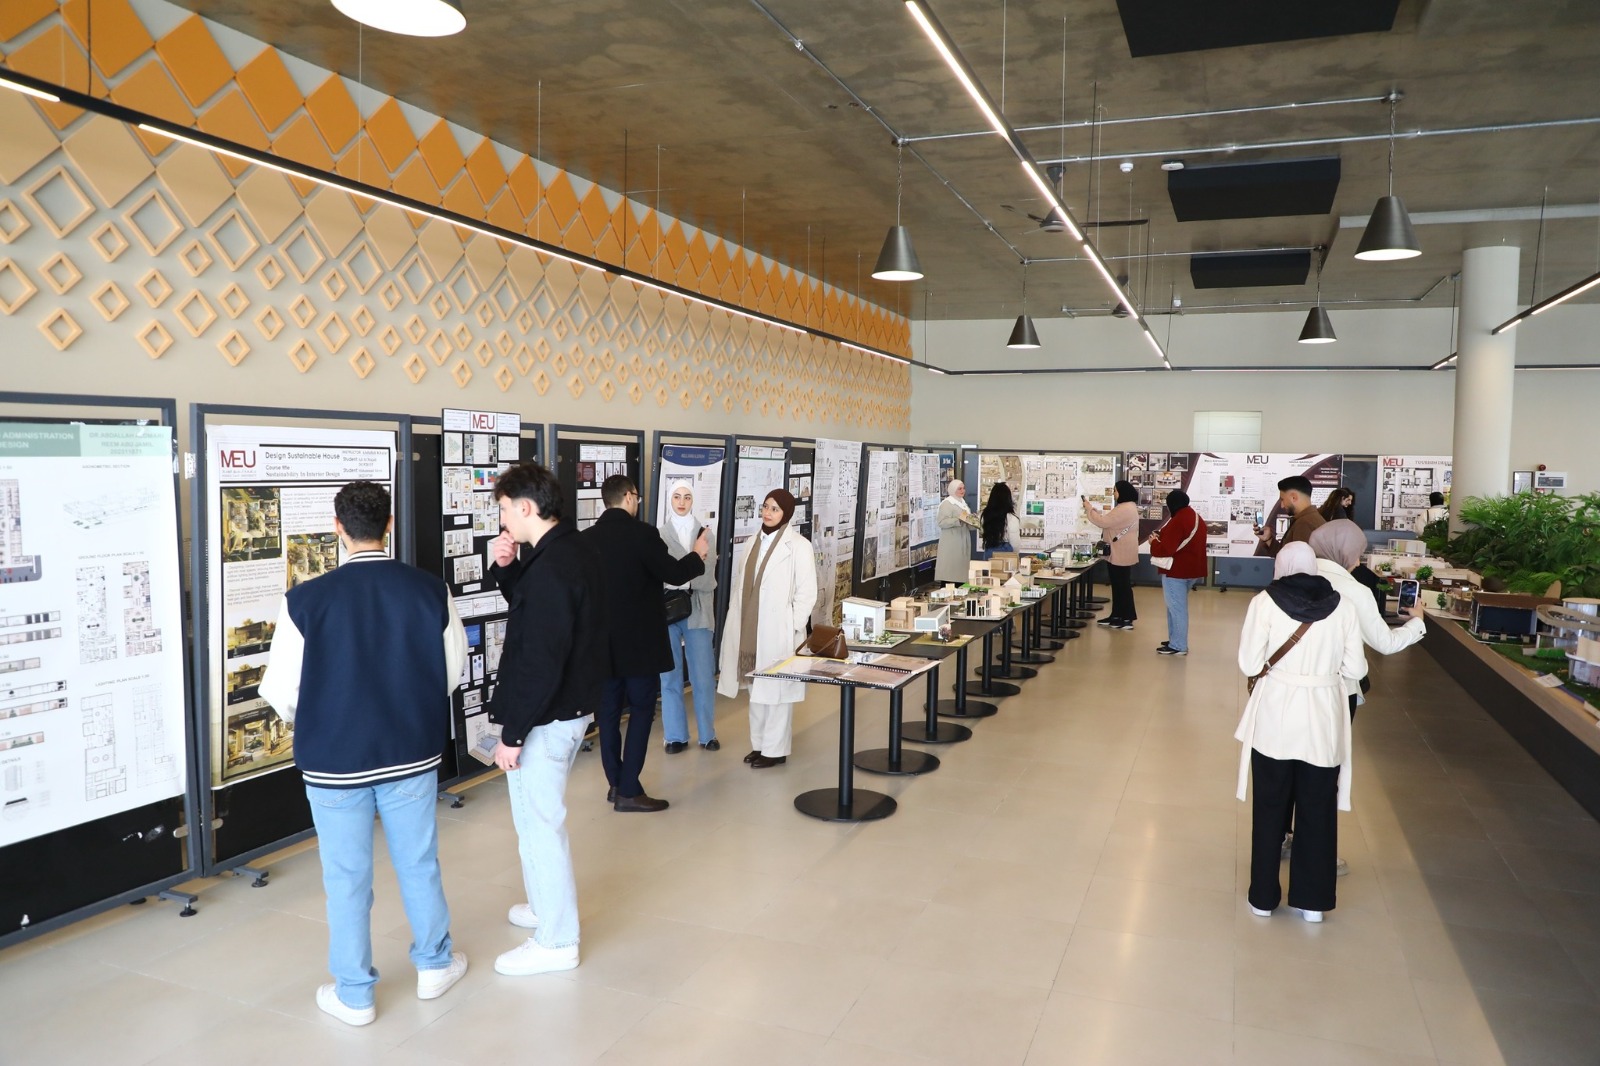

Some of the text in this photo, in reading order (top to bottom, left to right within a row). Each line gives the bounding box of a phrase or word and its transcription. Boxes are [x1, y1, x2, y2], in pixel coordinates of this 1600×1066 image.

[472, 413, 495, 430] MEU
[2, 431, 74, 440] ADMINISTRATION
[220, 450, 256, 468] MEU
[265, 451, 340, 460] Design Sustainable House
[1246, 455, 1269, 464] MEU
[1383, 458, 1404, 466] MEU
